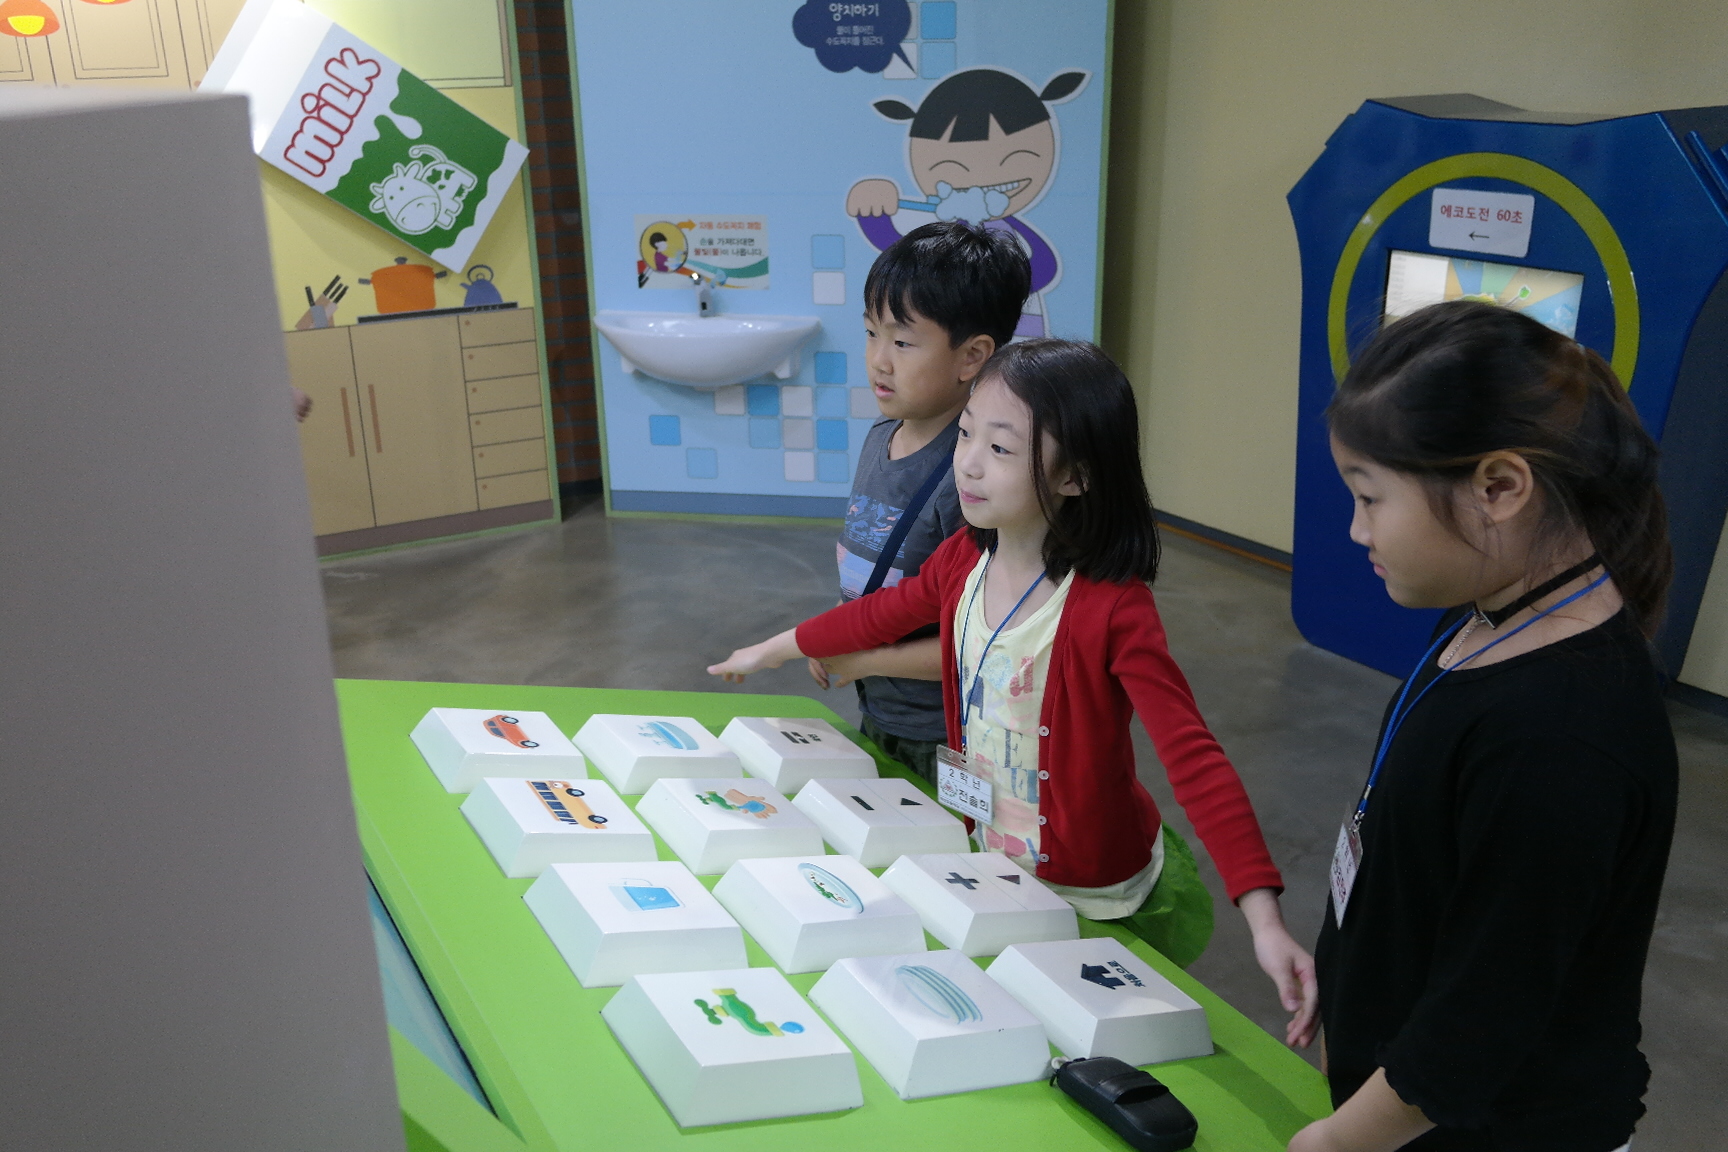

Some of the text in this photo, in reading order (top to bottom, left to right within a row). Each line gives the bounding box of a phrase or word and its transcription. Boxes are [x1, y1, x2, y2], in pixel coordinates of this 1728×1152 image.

[829, 3, 880, 21] 양치하기
[1440, 205, 1523, 224] 에코도전 60초
[700, 238, 714, 246] 손을
